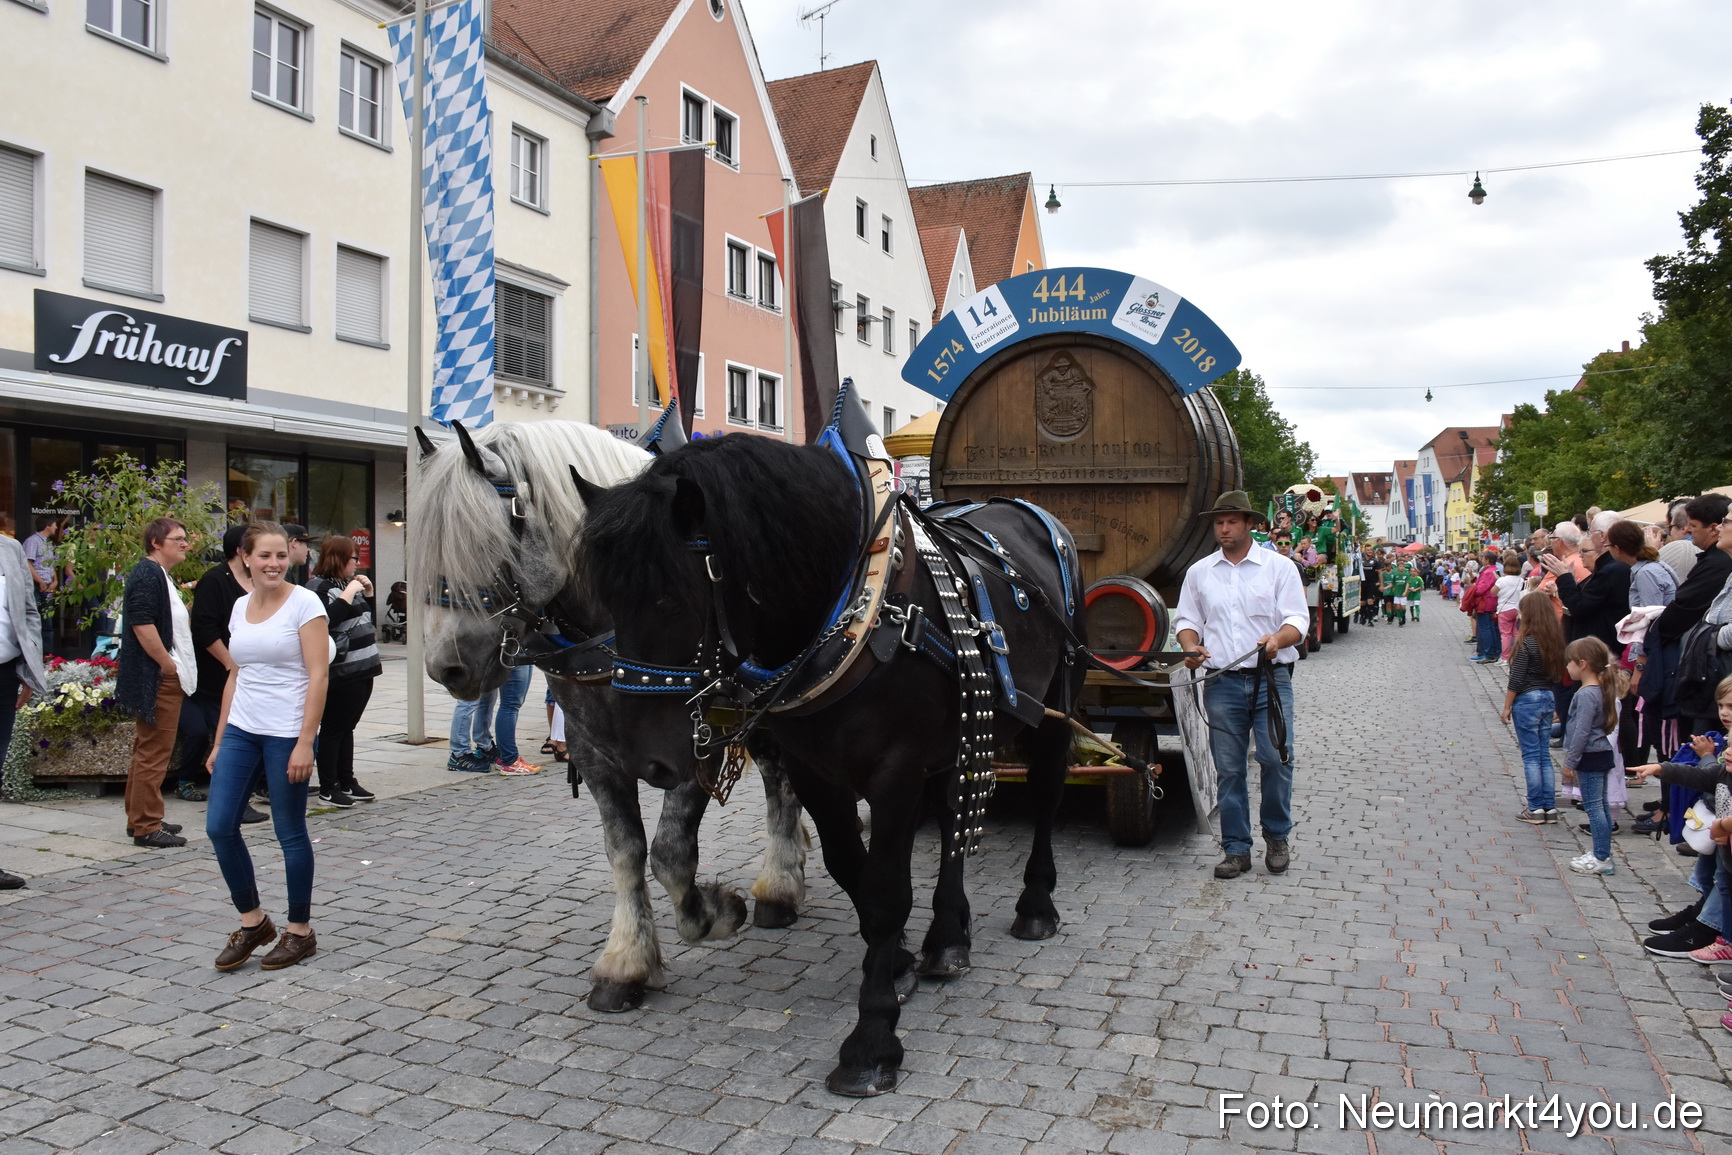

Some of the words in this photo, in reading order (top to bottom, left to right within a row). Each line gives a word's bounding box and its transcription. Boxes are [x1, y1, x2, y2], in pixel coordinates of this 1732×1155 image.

[1032, 273, 1086, 303] 444
[1089, 288, 1111, 304] Jahre
[966, 296, 998, 328] 14
[1027, 306, 1108, 324] Jubiläum
[1125, 302, 1166, 318] Glossner
[1139, 315, 1158, 329] Bräu
[970, 313, 1013, 341] Generationen
[974, 322, 1018, 350] Brautradition
[926, 338, 965, 385] 1574
[1172, 328, 1217, 373] 2018
